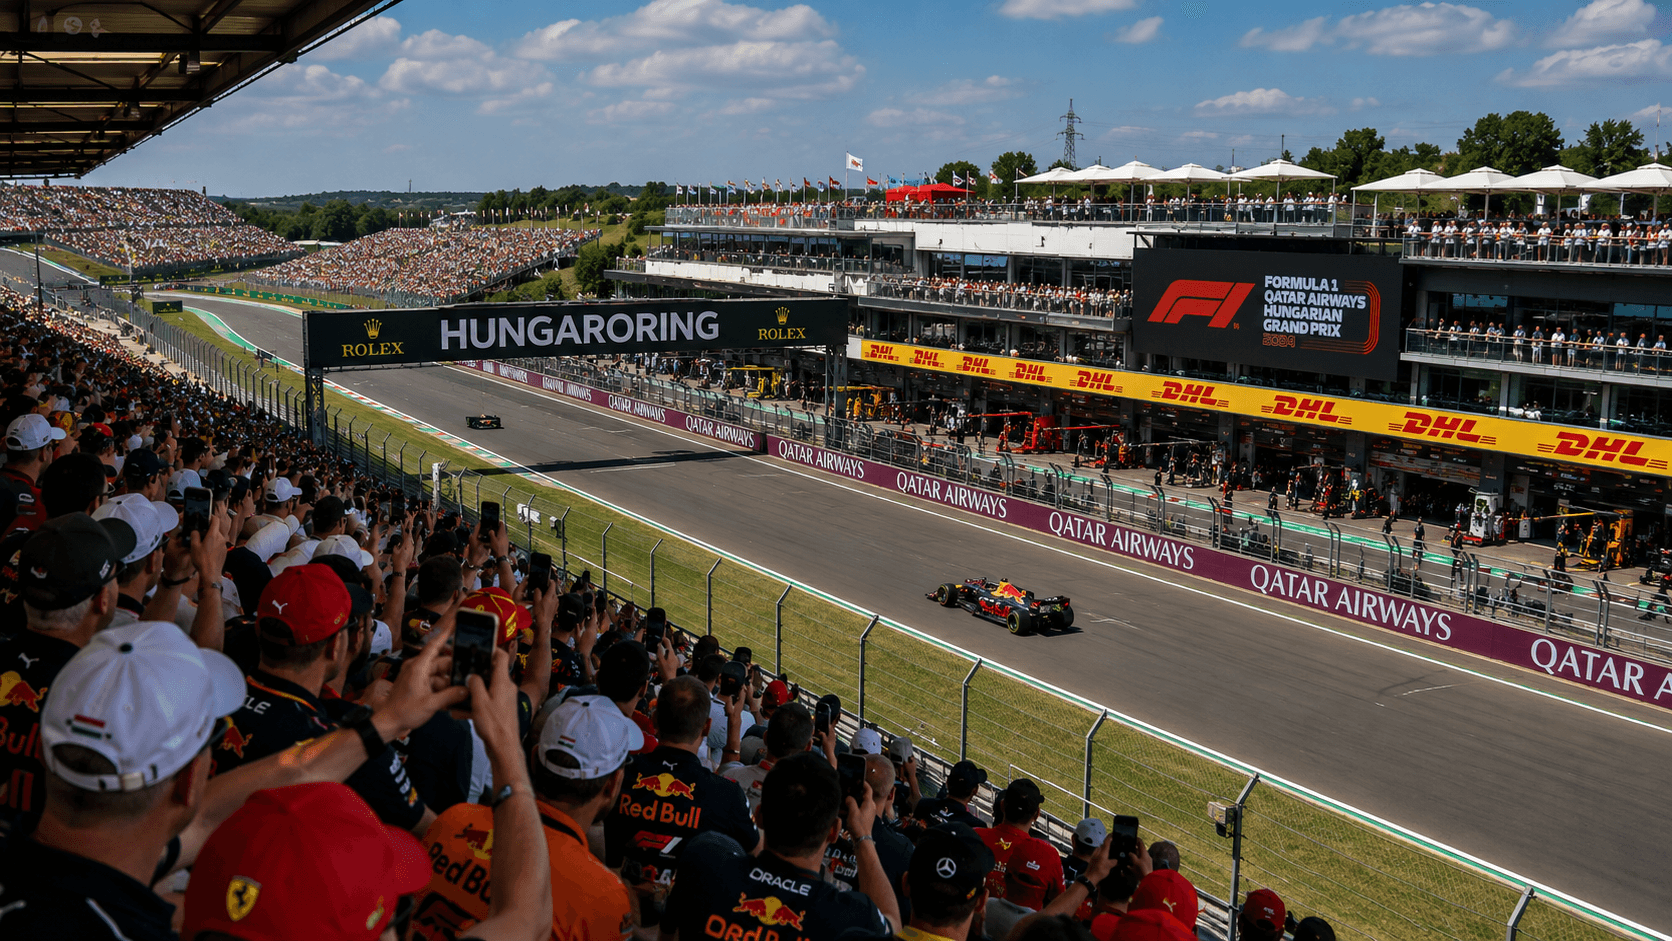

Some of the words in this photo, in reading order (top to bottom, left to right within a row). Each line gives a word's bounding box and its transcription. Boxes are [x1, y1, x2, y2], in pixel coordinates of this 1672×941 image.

[1264, 275, 1330, 292] FORMULA
[1331, 278, 1339, 292] 1
[1263, 304, 1343, 323] HUNGARIAN
[1264, 289, 1306, 305] QATAR
[1306, 292, 1367, 310] AIRWAYS
[440, 310, 720, 350] HUNGARORING
[757, 327, 806, 341] ROLEX
[1262, 318, 1309, 335] GRAND
[1309, 323, 1342, 338] PRIX
[341, 341, 405, 358] ROLEX
[1015, 362, 1046, 382] DHL
[1077, 370, 1115, 391] DHL
[1161, 380, 1218, 406] DHL
[1273, 395, 1339, 423] DHL
[685, 414, 714, 436] QATAR
[715, 423, 755, 448] AIRWAYS
[1403, 411, 1481, 443] DHL
[778, 439, 814, 465] QATAR
[816, 450, 865, 479] AIRWAYS
[1554, 431, 1649, 467] DHL
[896, 471, 941, 501] QATAR
[943, 484, 1008, 519] AIRWAYS
[1049, 511, 1106, 547] QATAR
[1110, 529, 1195, 570] AIRWAYS
[1250, 564, 1329, 608] QATAR
[1334, 586, 1452, 642] AIRWAYS
[1530, 638, 1645, 696] QATAR
[619, 793, 659, 821] Red
[660, 802, 702, 829] Bull
[749, 867, 811, 896] ORACLE
